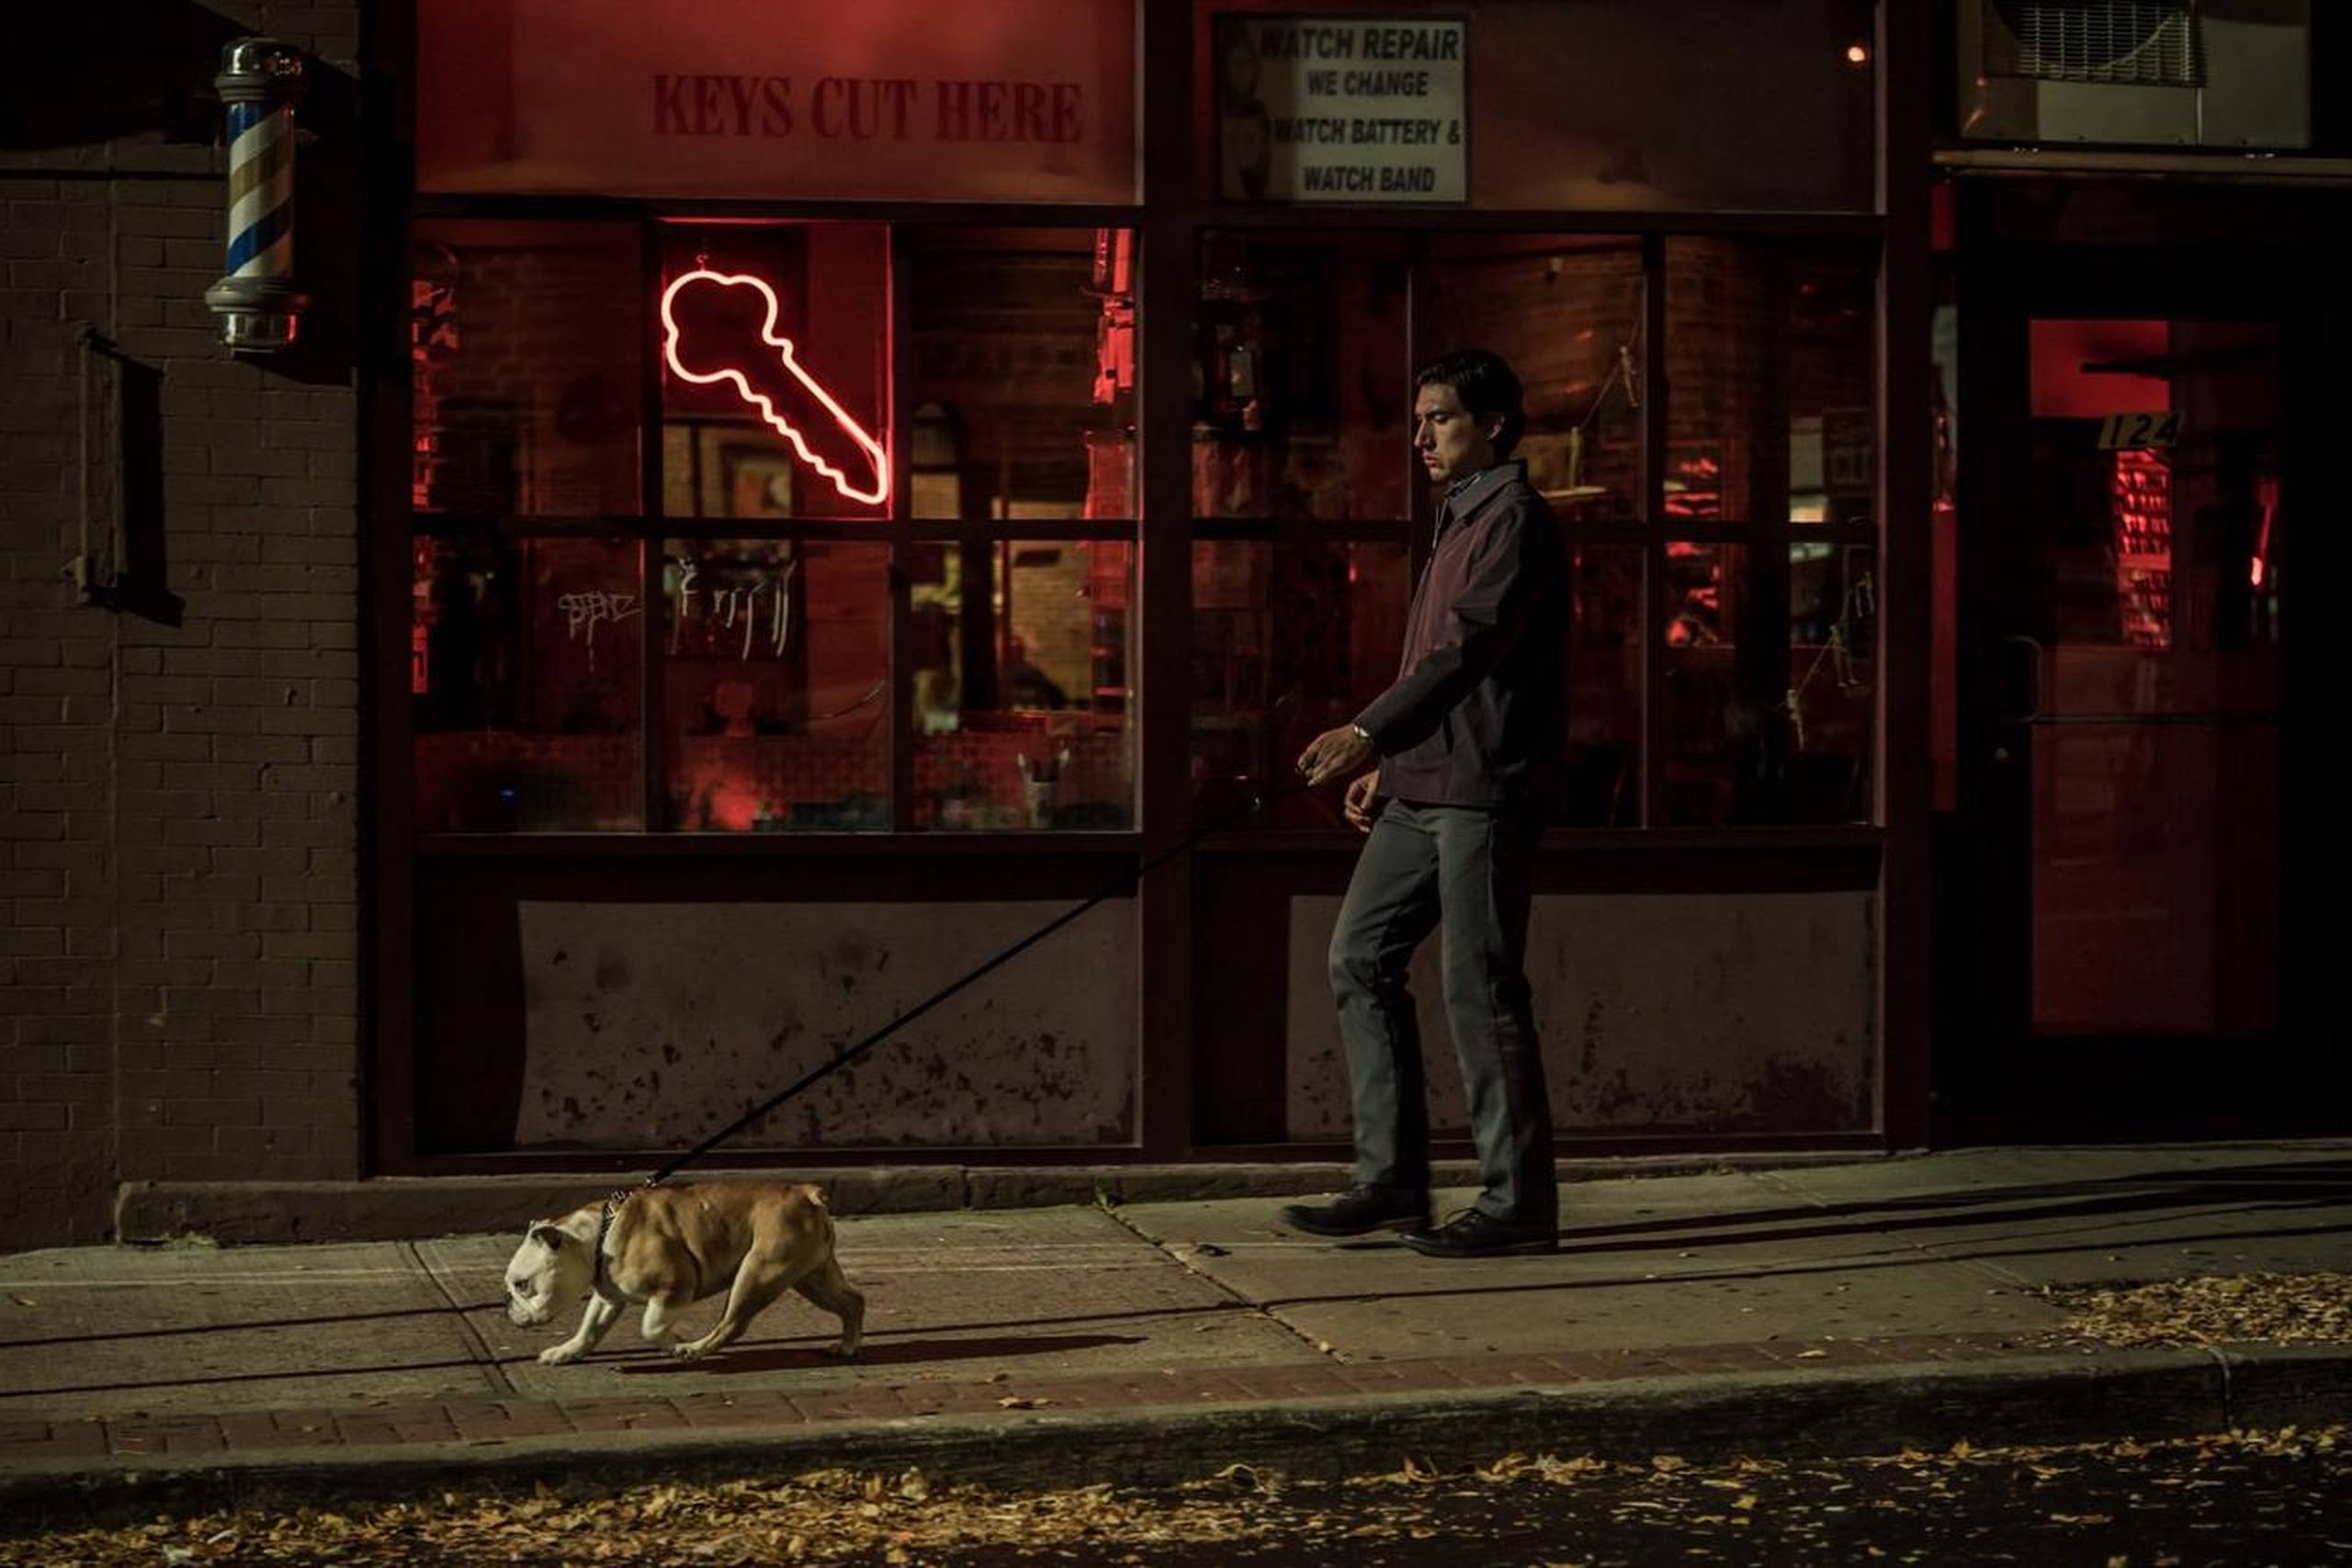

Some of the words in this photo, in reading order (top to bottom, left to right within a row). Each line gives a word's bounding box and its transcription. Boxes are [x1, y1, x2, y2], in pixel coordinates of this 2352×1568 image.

[1261, 28, 1353, 59] WATCH
[1364, 28, 1459, 60] REPAIR
[1307, 70, 1338, 95] WE
[1343, 71, 1429, 96] CHANGE
[650, 73, 792, 138] KEYS
[811, 77, 917, 140] CUT
[935, 80, 1082, 142] HERE
[1275, 118, 1344, 143] WATCH
[1351, 118, 1441, 144] BATTERY
[1448, 120, 1461, 144] &
[1304, 166, 1373, 191] WATCH
[1381, 166, 1435, 192] BAND
[2110, 413, 2177, 444] 124
